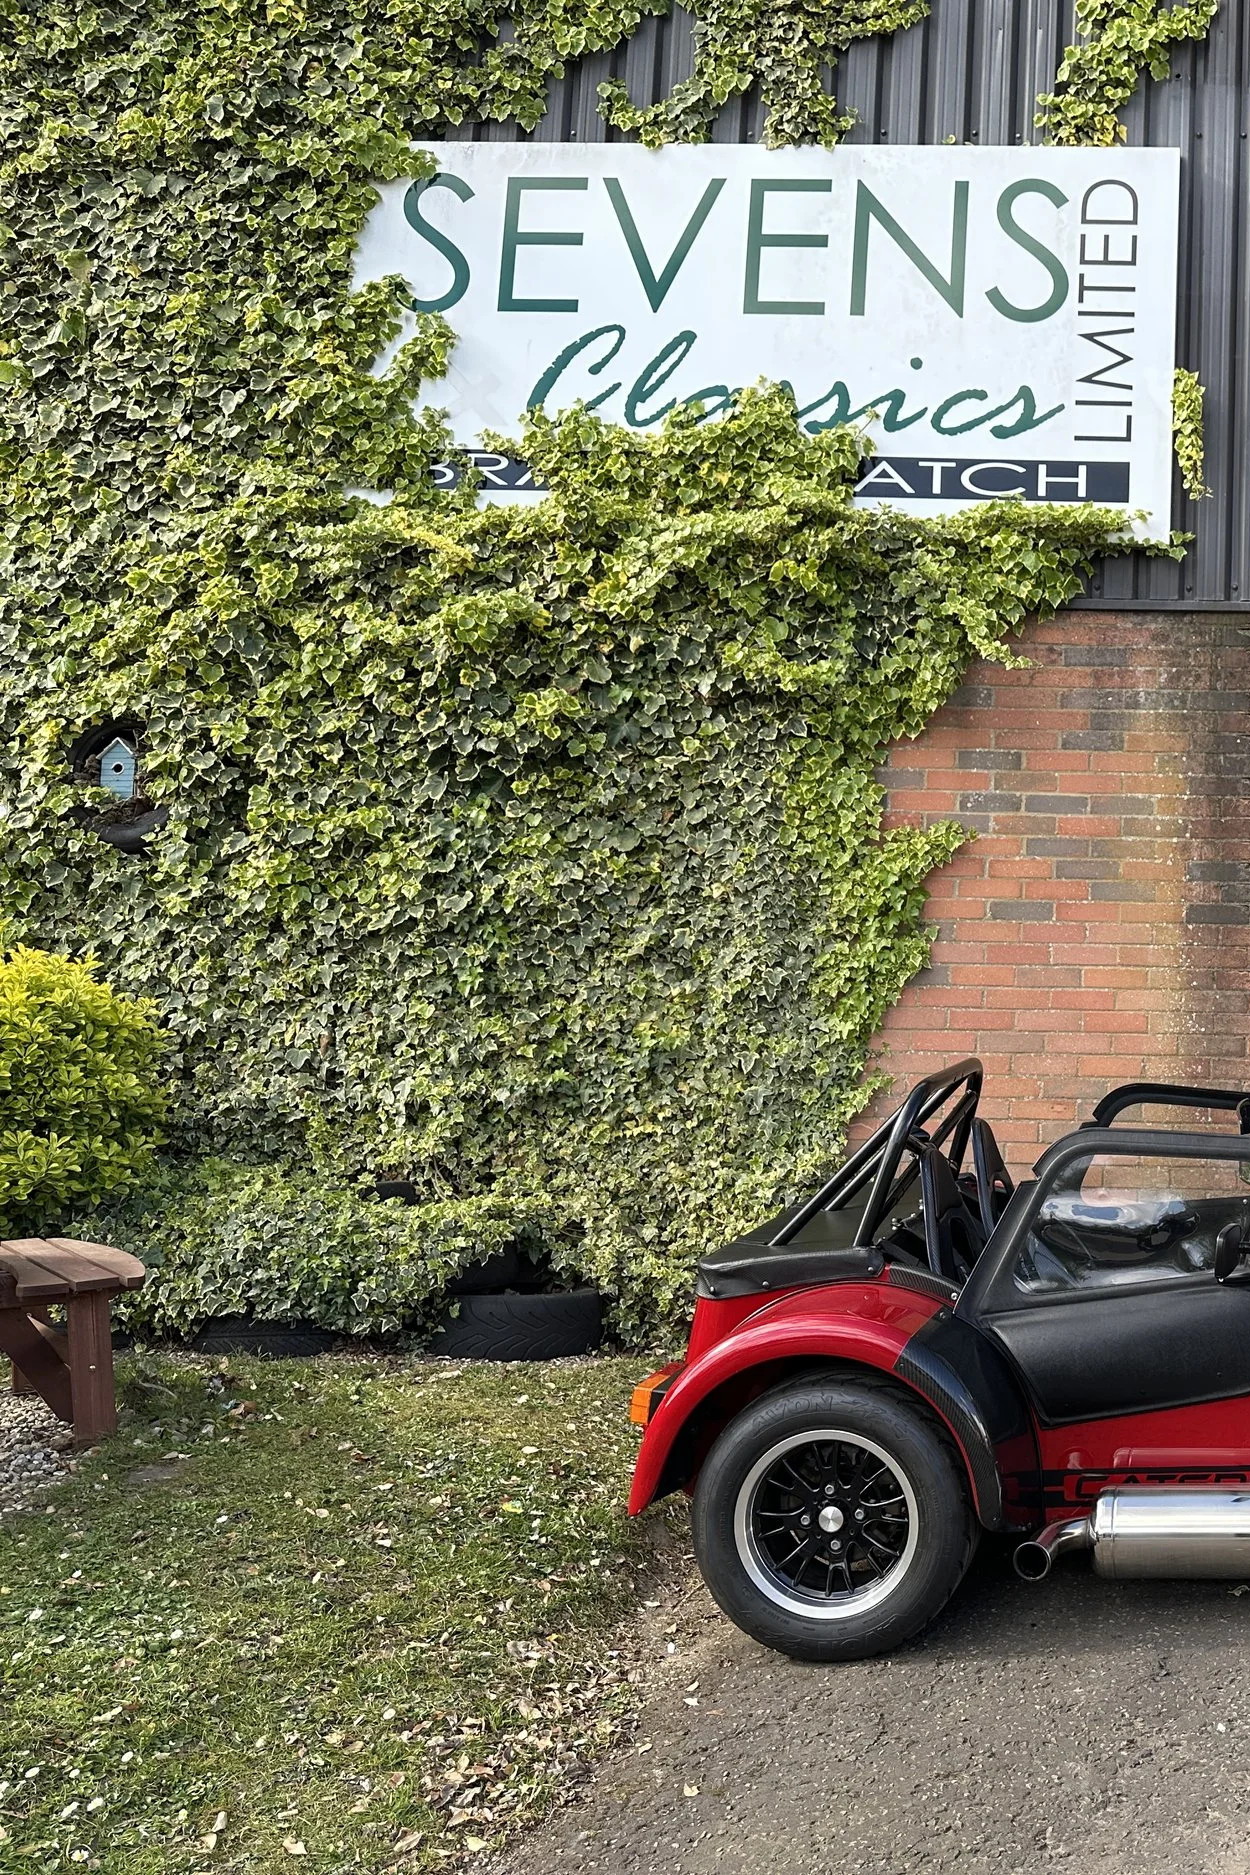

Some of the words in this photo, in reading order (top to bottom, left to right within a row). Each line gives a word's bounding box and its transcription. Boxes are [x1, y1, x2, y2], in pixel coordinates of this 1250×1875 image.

[396, 172, 1070, 323] SEVENS
[1074, 179, 1139, 442] LIMITED
[527, 324, 1066, 440] Clasics
[854, 459, 1088, 498] ATCH
